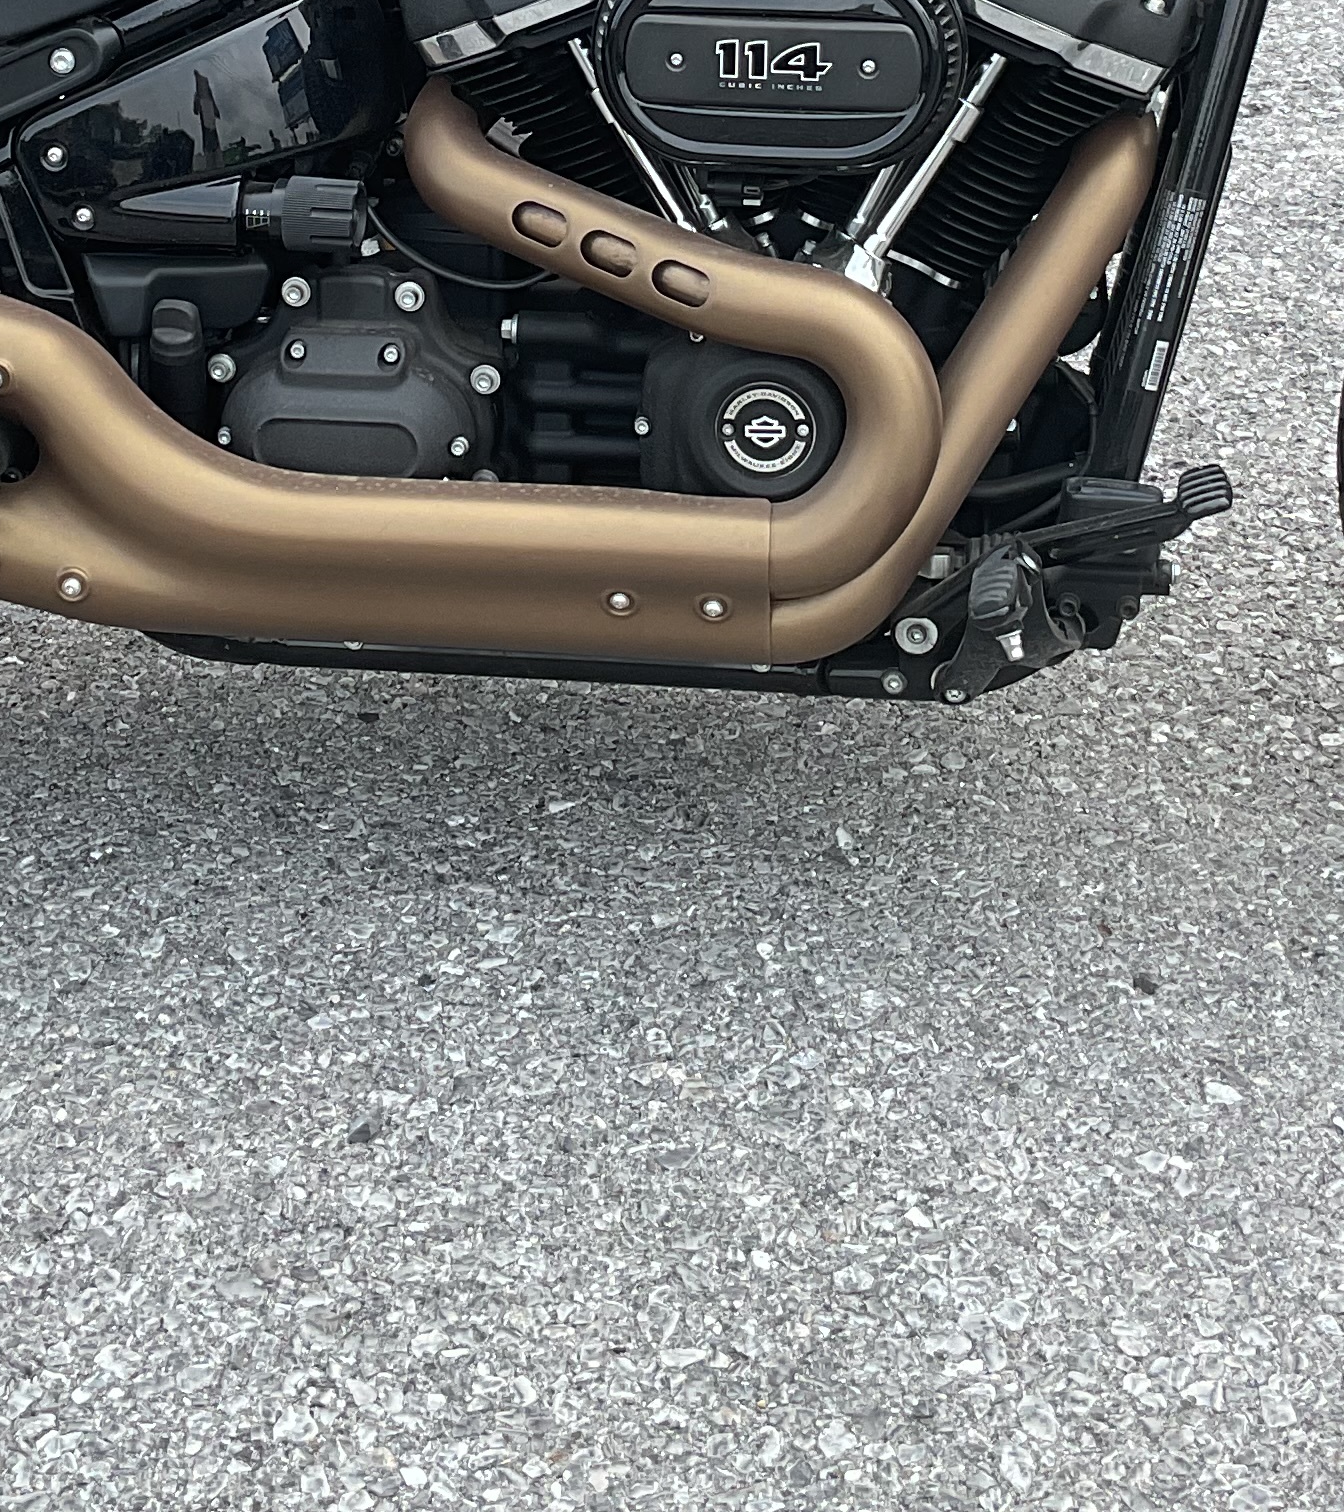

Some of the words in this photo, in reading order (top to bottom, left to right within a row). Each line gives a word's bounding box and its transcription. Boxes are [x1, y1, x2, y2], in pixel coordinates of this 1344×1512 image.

[715, 38, 834, 82] 114
[718, 81, 762, 89] CUBIC
[771, 82, 823, 92] INCHES
